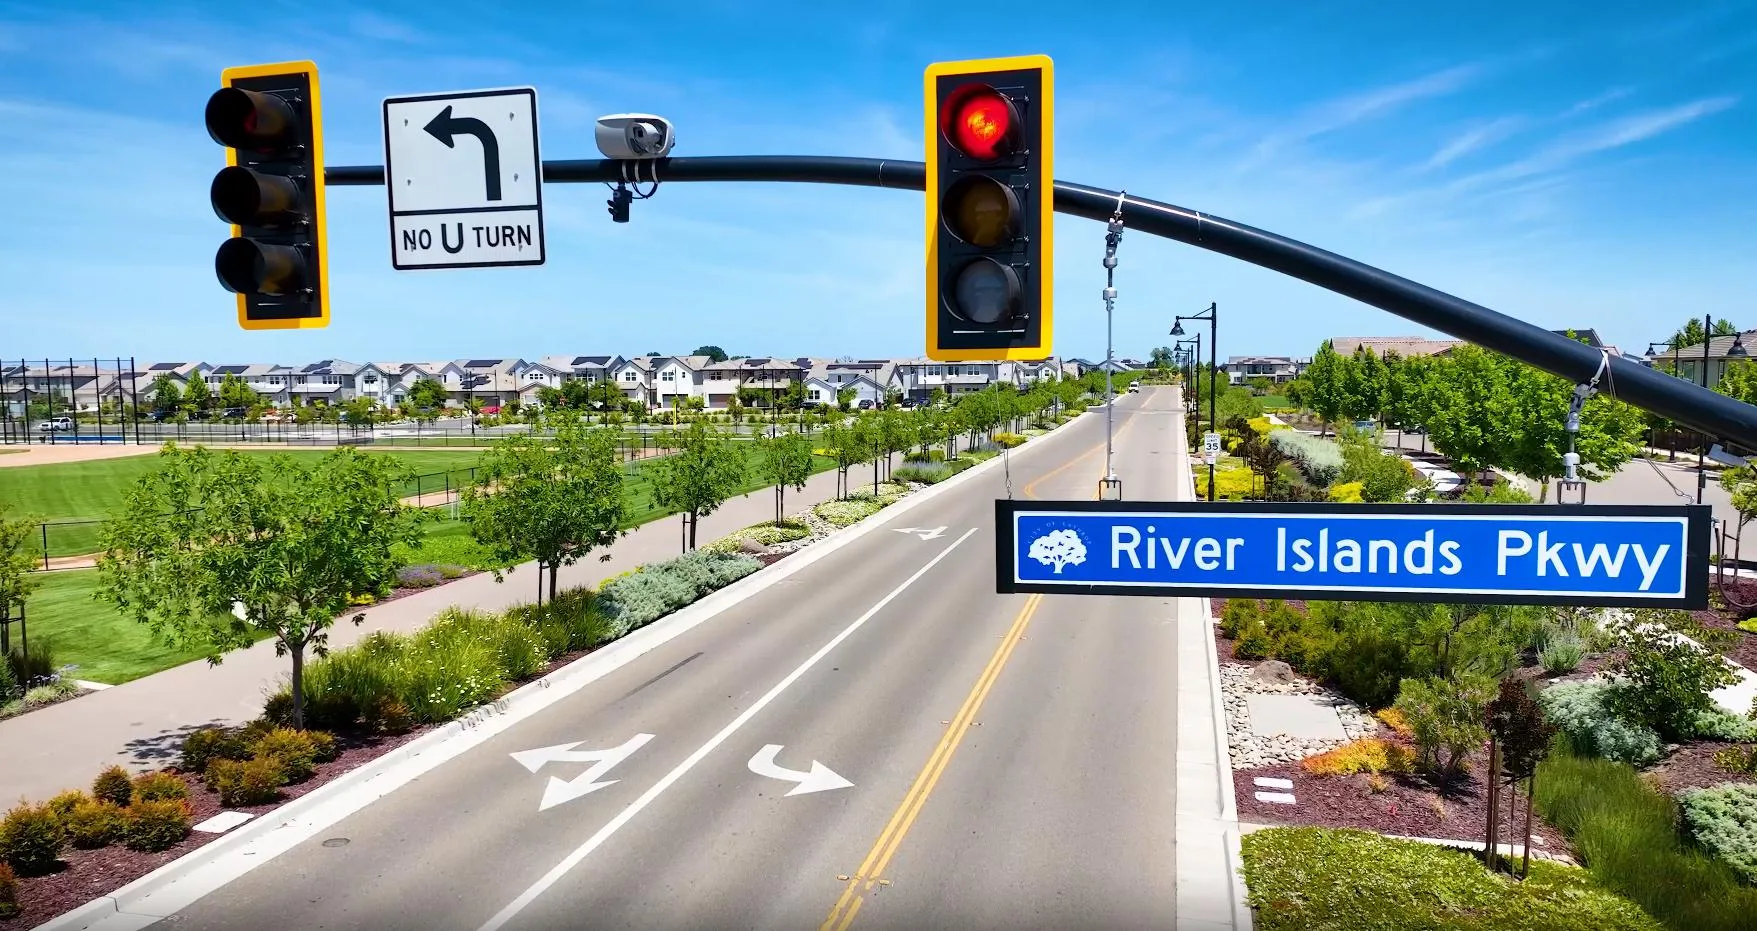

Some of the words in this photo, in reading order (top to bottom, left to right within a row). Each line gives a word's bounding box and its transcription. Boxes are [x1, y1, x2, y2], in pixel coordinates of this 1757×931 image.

[403, 229, 432, 250] NO
[441, 222, 464, 254] U
[472, 225, 531, 248] TURN
[1111, 525, 1245, 571] River
[1277, 527, 1462, 576] Islands
[1497, 529, 1671, 591] Pkwy
